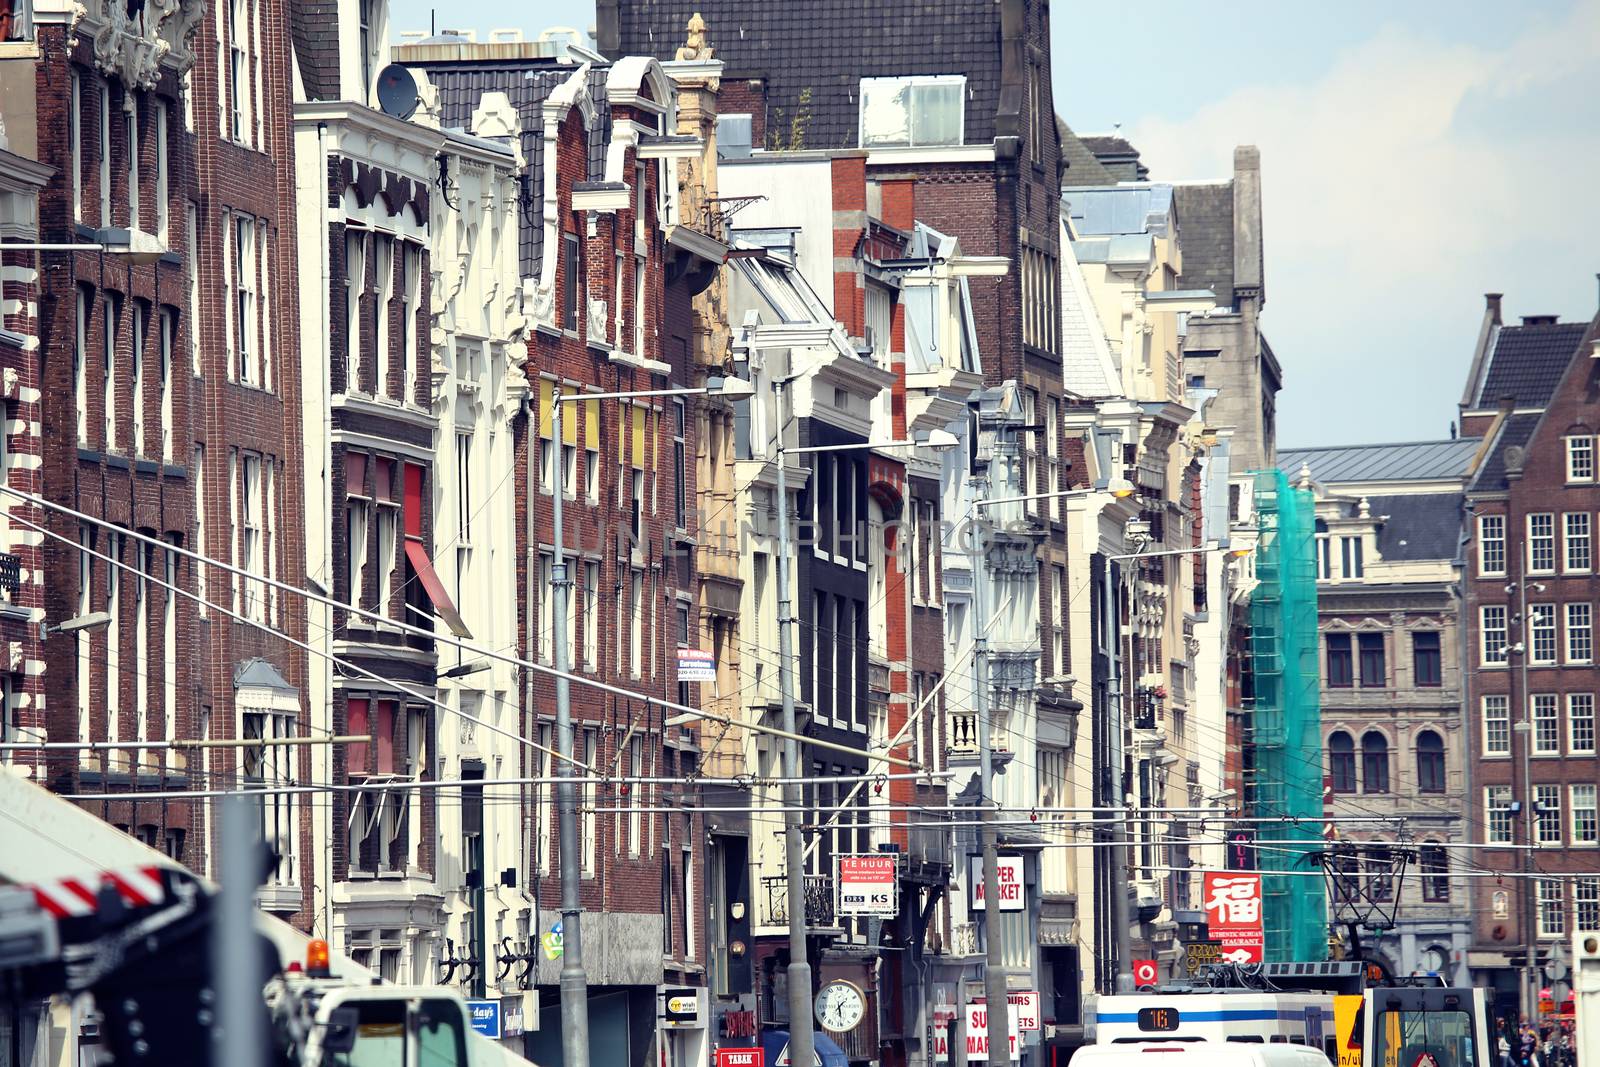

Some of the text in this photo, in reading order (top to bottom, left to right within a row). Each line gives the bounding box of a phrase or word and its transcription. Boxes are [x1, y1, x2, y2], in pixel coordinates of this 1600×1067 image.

[844, 860, 891, 868] TE HUUR
[975, 884, 1020, 900] MKET
[871, 894, 888, 903] KS
[1205, 876, 1260, 924] 福
[728, 1055, 752, 1064] TABAK
